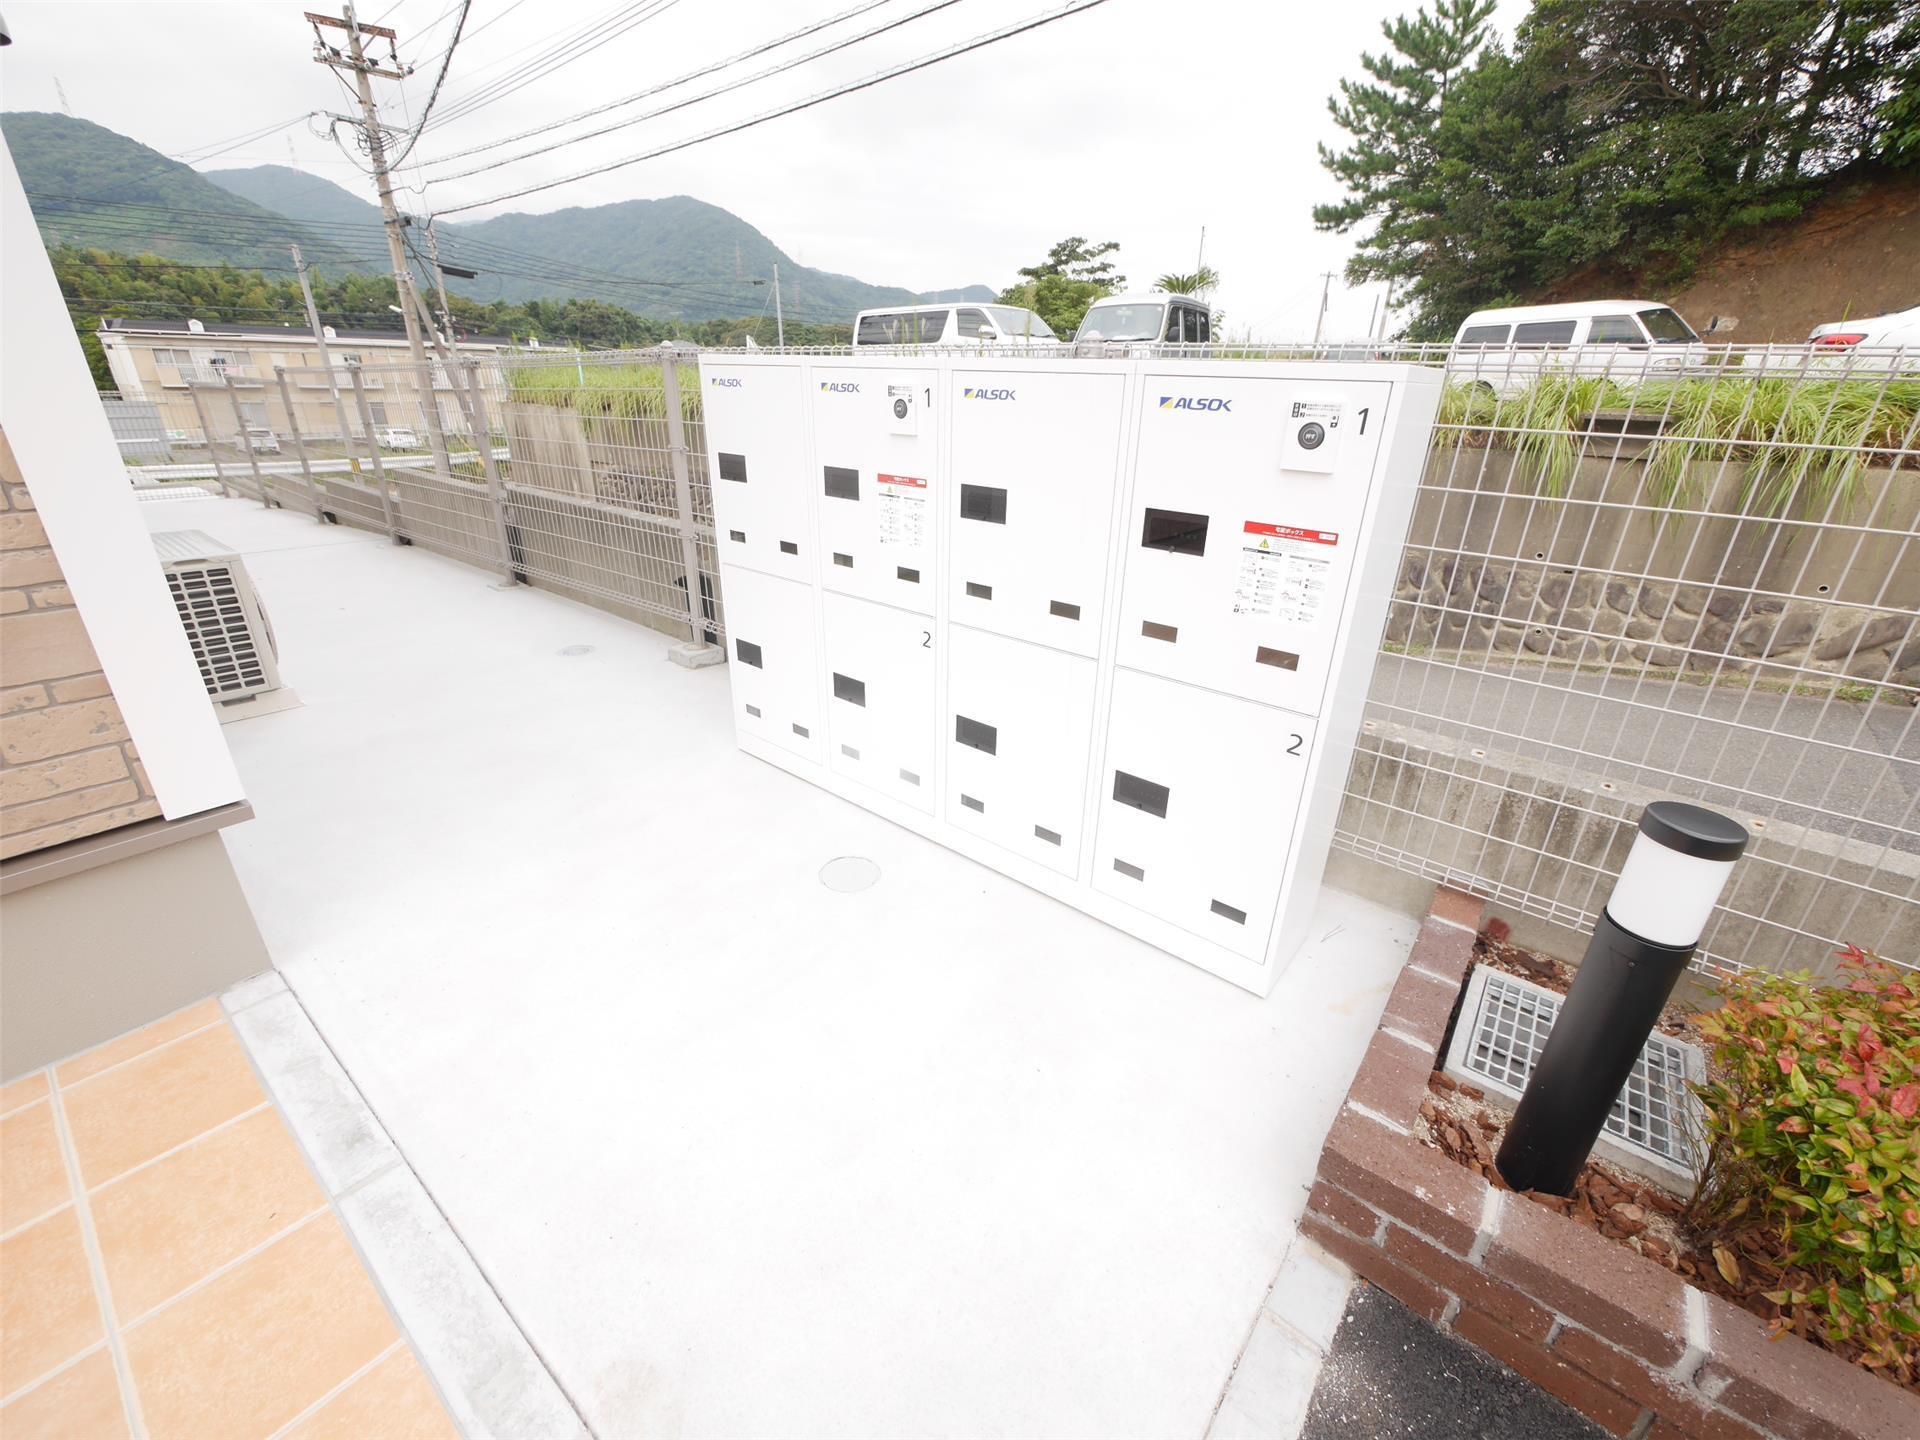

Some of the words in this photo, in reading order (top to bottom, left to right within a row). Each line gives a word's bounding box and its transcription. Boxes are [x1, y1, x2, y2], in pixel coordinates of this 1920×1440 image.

[718, 378, 742, 387] ALSOK
[829, 382, 860, 393] ALSOK
[924, 387, 931, 408] 1
[975, 388, 1016, 401] ALSOK
[1173, 397, 1232, 412] ALSOK
[1358, 408, 1370, 436] 1
[922, 630, 931, 649] 2
[1286, 733, 1303, 756] 2
